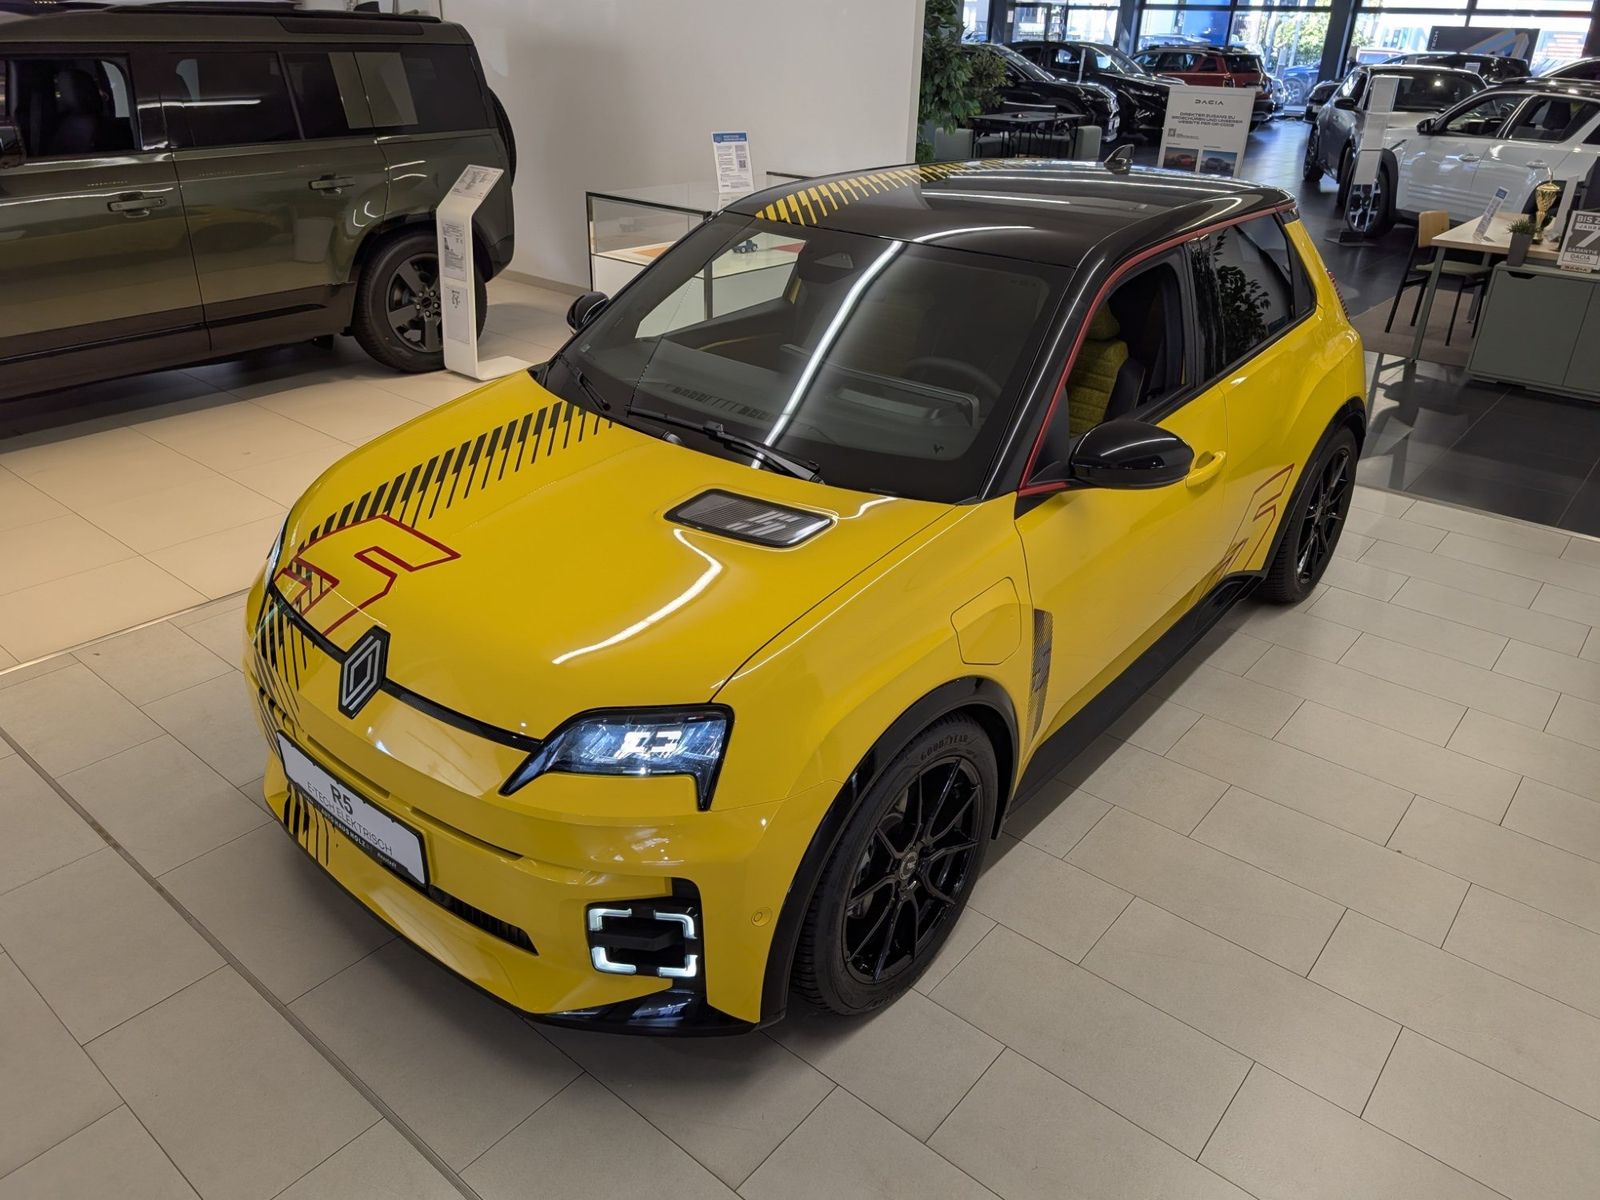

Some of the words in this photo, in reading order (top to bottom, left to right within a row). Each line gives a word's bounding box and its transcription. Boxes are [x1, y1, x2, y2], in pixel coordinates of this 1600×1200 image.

[1577, 215, 1593, 224] BIS
[330, 784, 353, 815] R5
[307, 781, 335, 813] E-TECH
[336, 806, 393, 856] ELEKTRISCH
